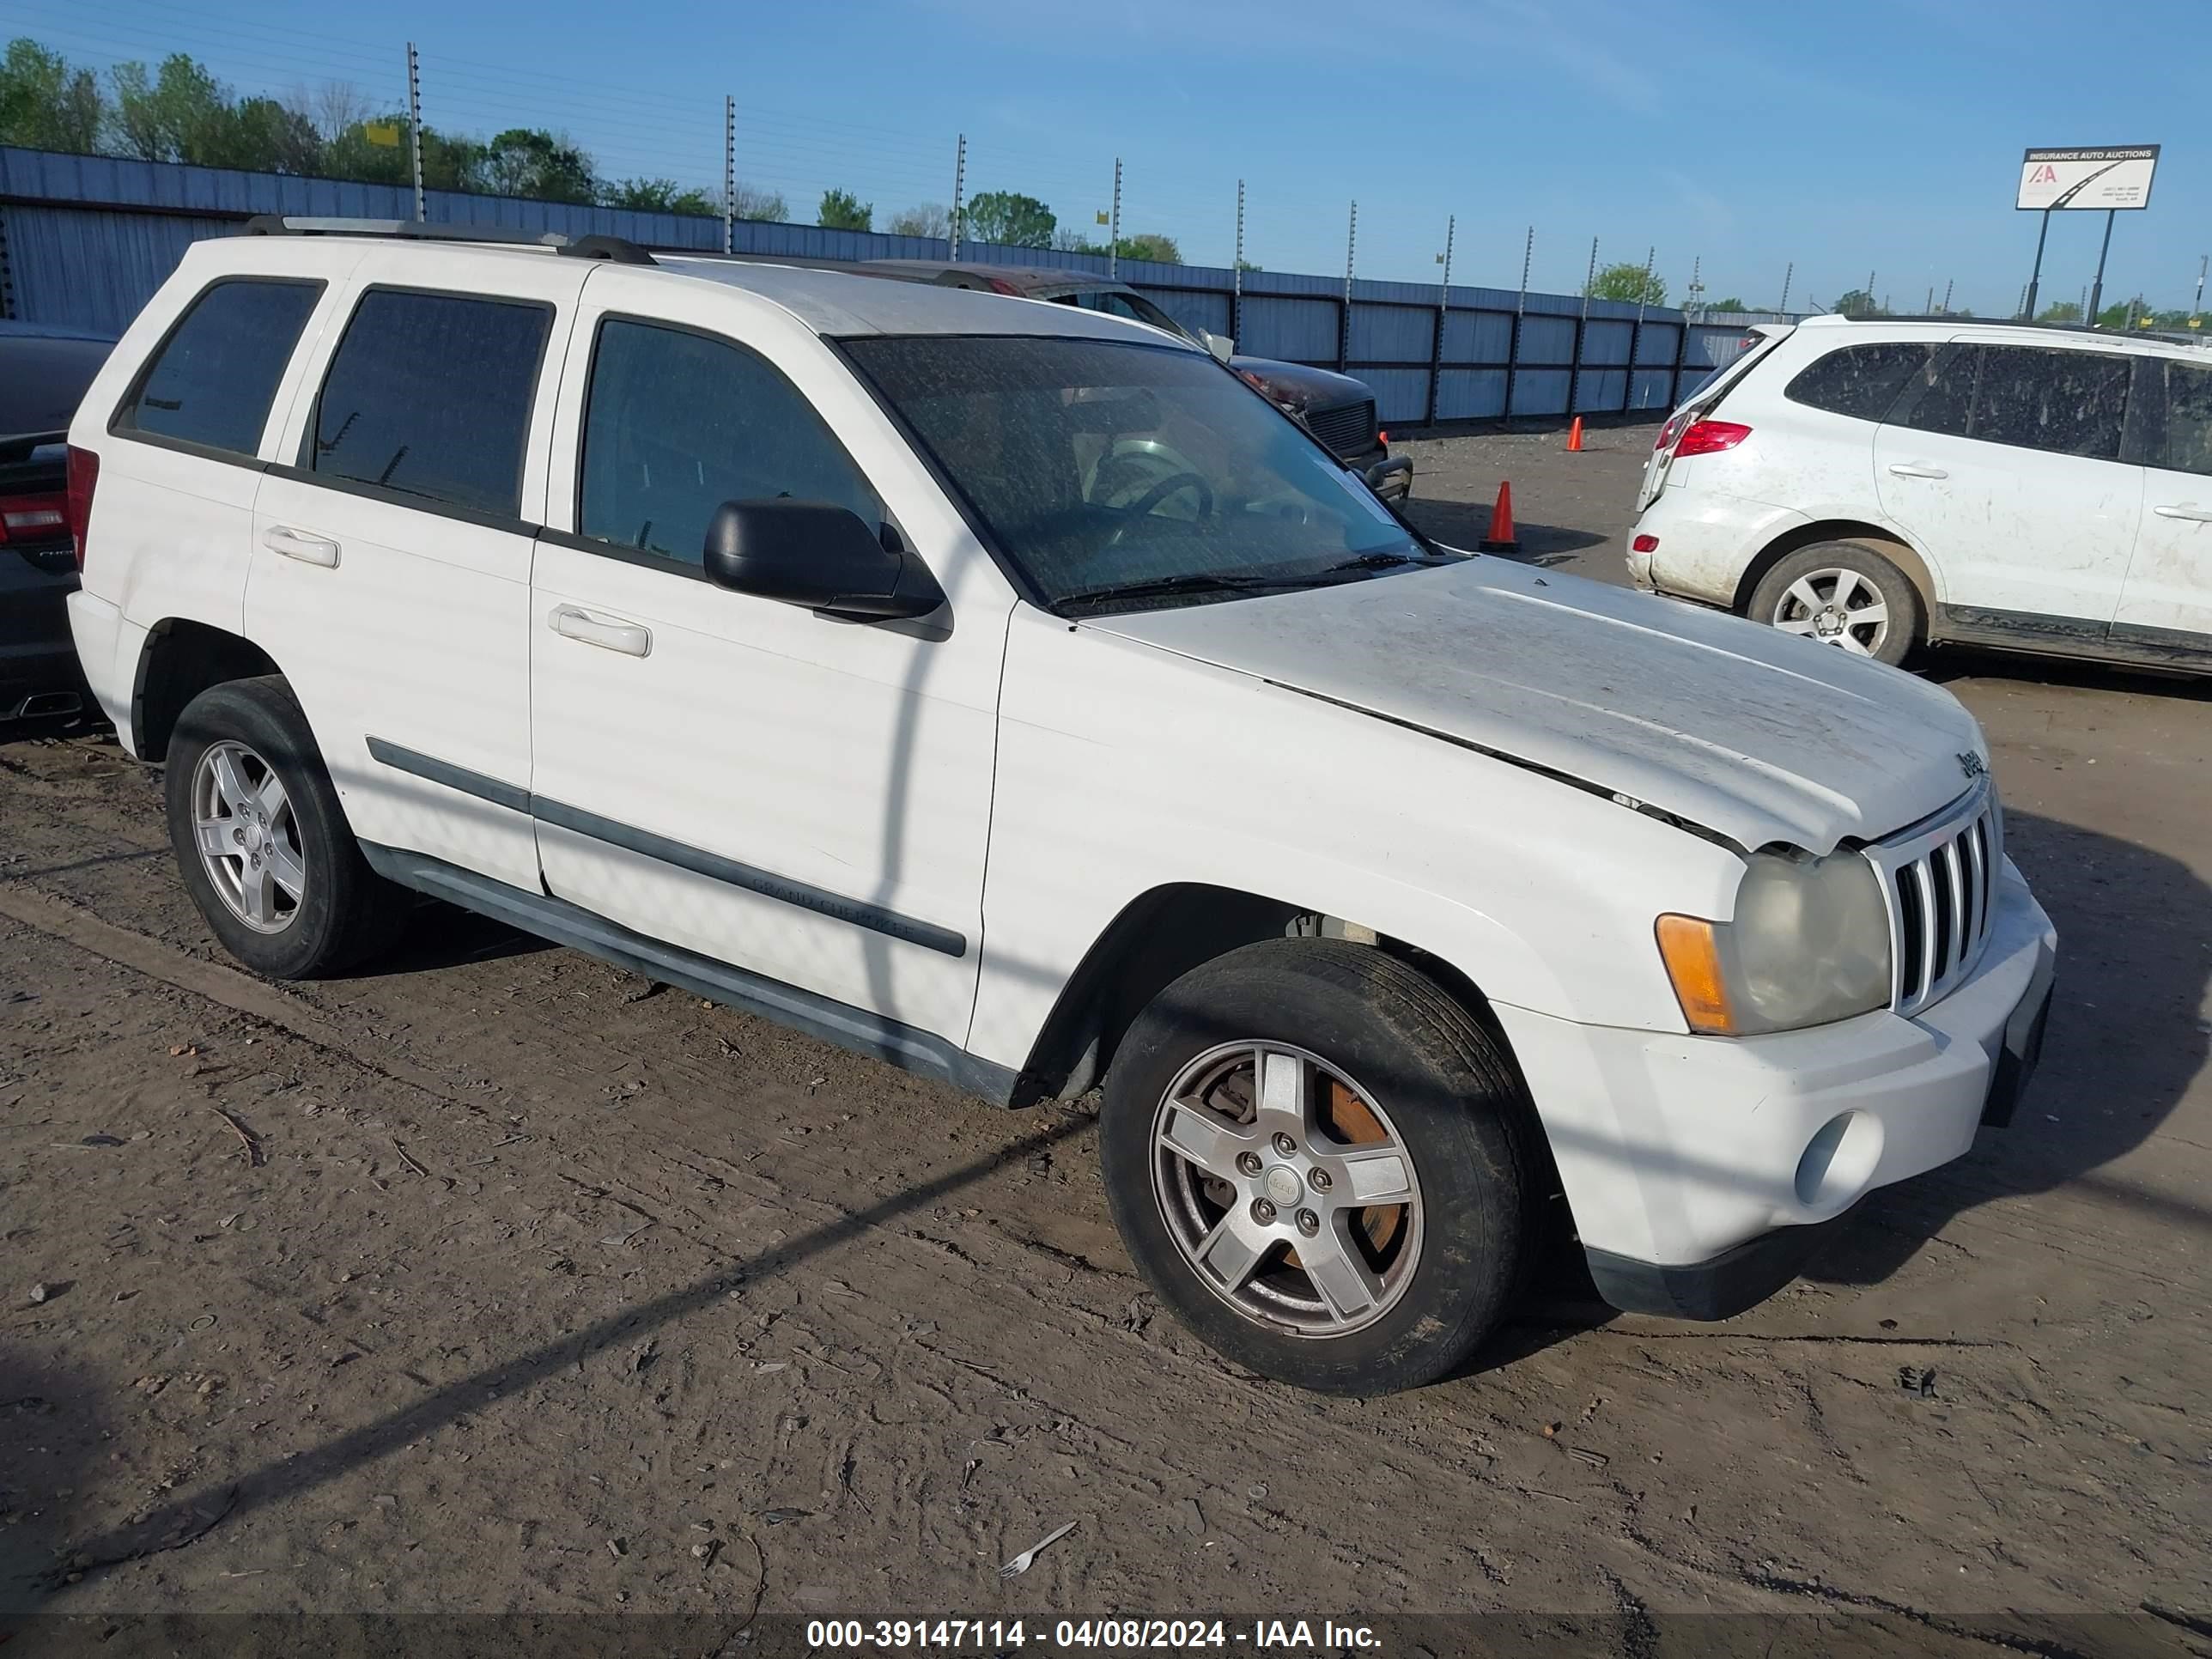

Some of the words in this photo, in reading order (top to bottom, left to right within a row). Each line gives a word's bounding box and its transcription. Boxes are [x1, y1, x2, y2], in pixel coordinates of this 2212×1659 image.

[2029, 151, 2079, 161] INSURANCE
[2080, 151, 2104, 160] AUTO
[2106, 149, 2152, 159] AUCTIONS
[752, 878, 813, 904] GRAND
